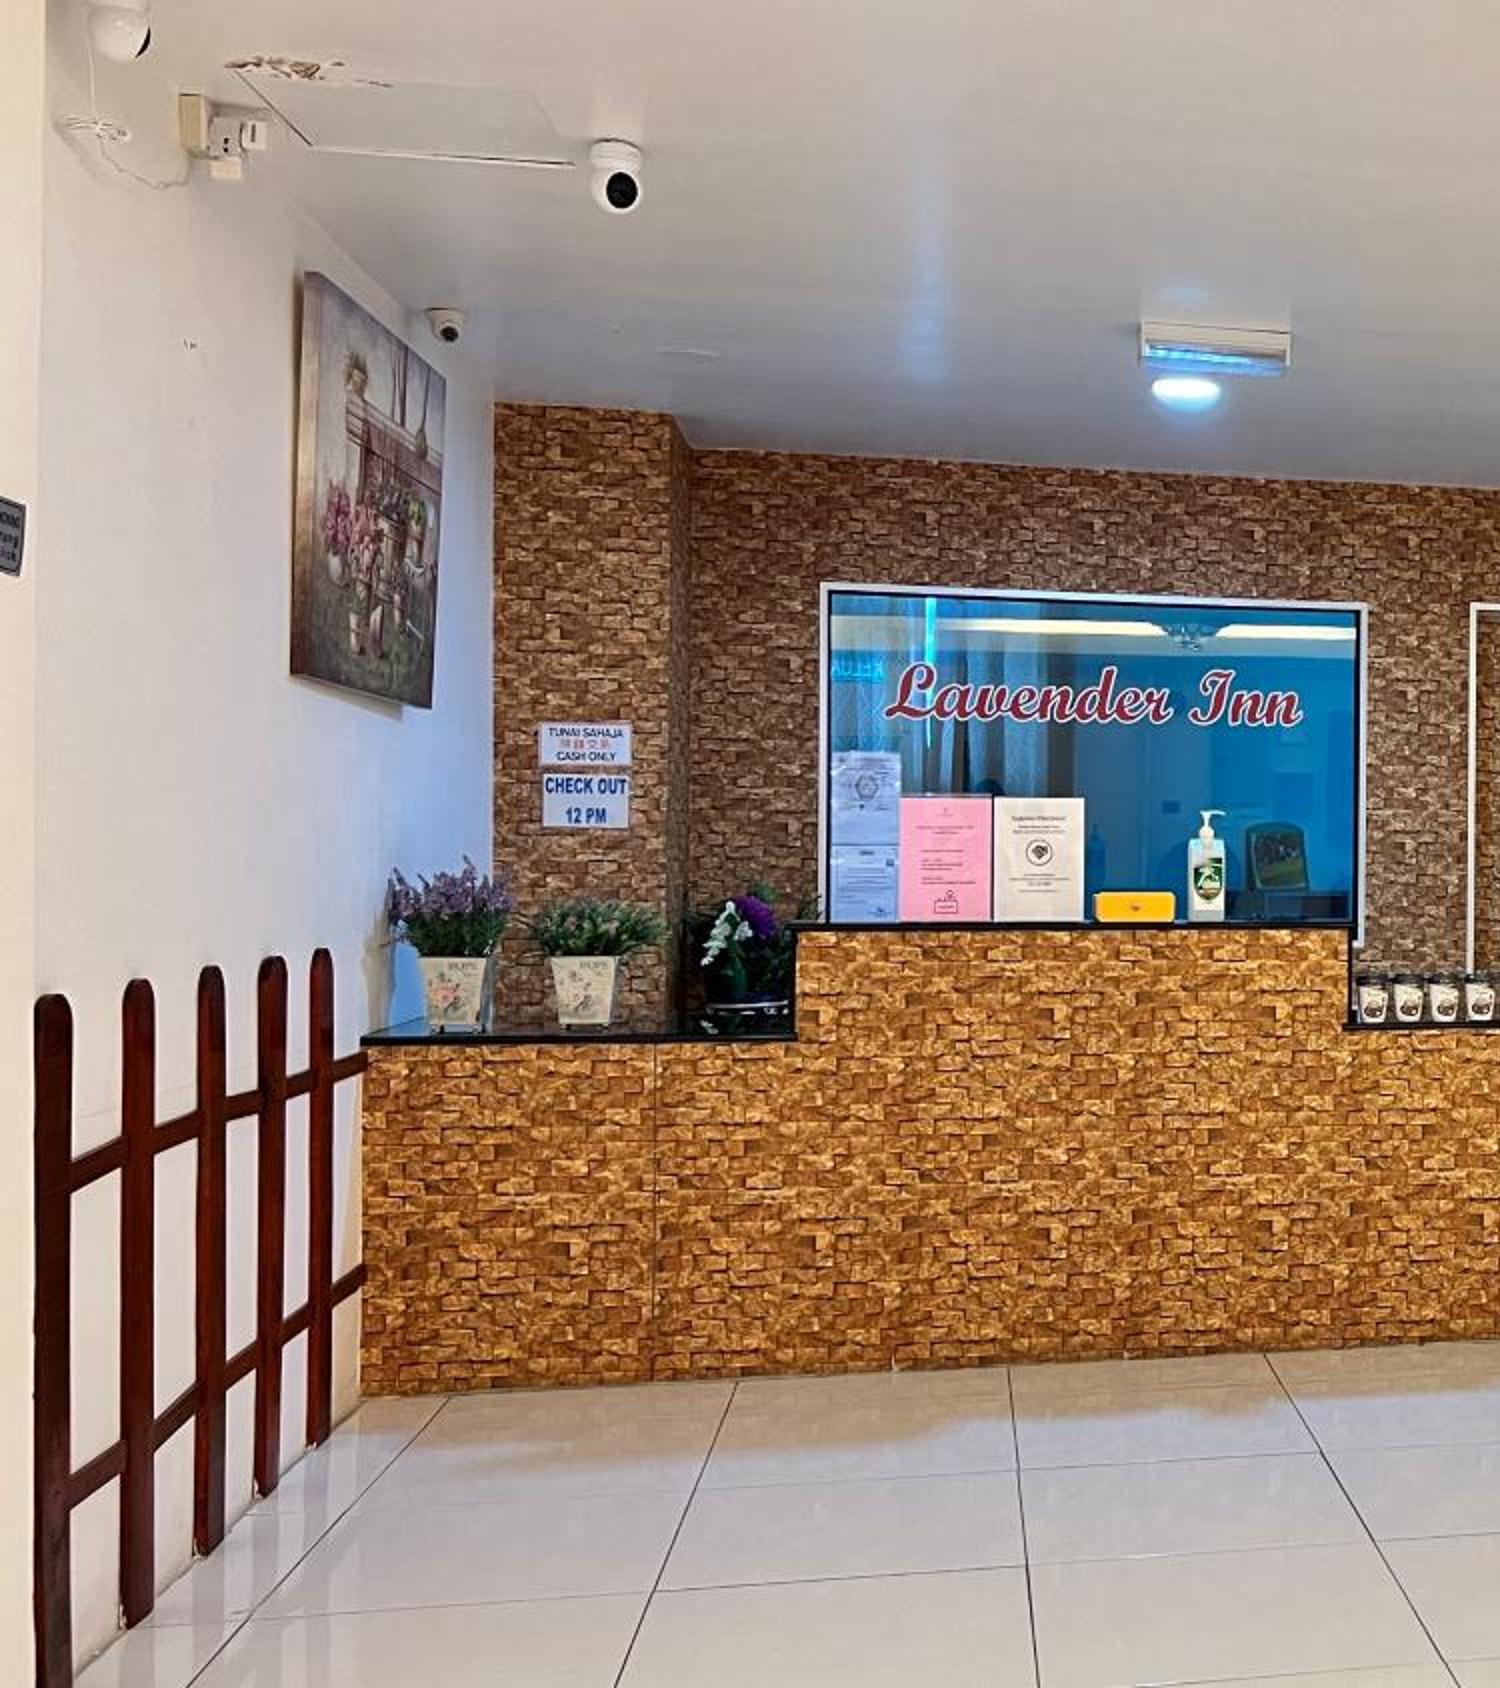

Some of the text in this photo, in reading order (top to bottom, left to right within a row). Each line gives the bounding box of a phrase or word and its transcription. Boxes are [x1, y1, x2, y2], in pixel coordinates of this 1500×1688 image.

[885, 661, 1174, 725] Lavender
[1189, 669, 1303, 727] Inn
[549, 727, 624, 739] TUNAI SAHAJA
[557, 751, 617, 761] CASH ONLY
[545, 777, 627, 794] CHECK OUT
[565, 807, 607, 824] 12 PM
